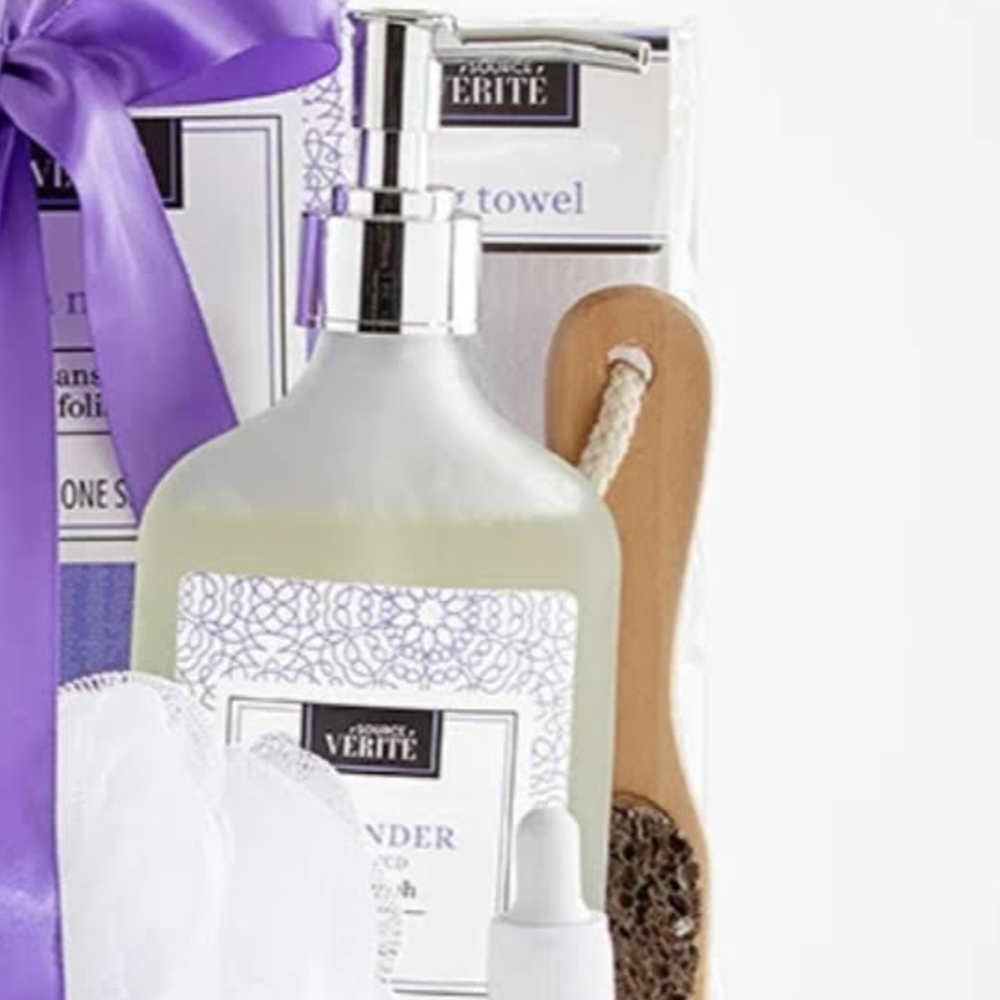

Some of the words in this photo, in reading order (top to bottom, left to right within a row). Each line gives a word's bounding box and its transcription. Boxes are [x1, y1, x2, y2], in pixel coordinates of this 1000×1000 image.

[477, 181, 585, 216] towel
[61, 478, 109, 511] ONE
[365, 823, 457, 851] NDER
